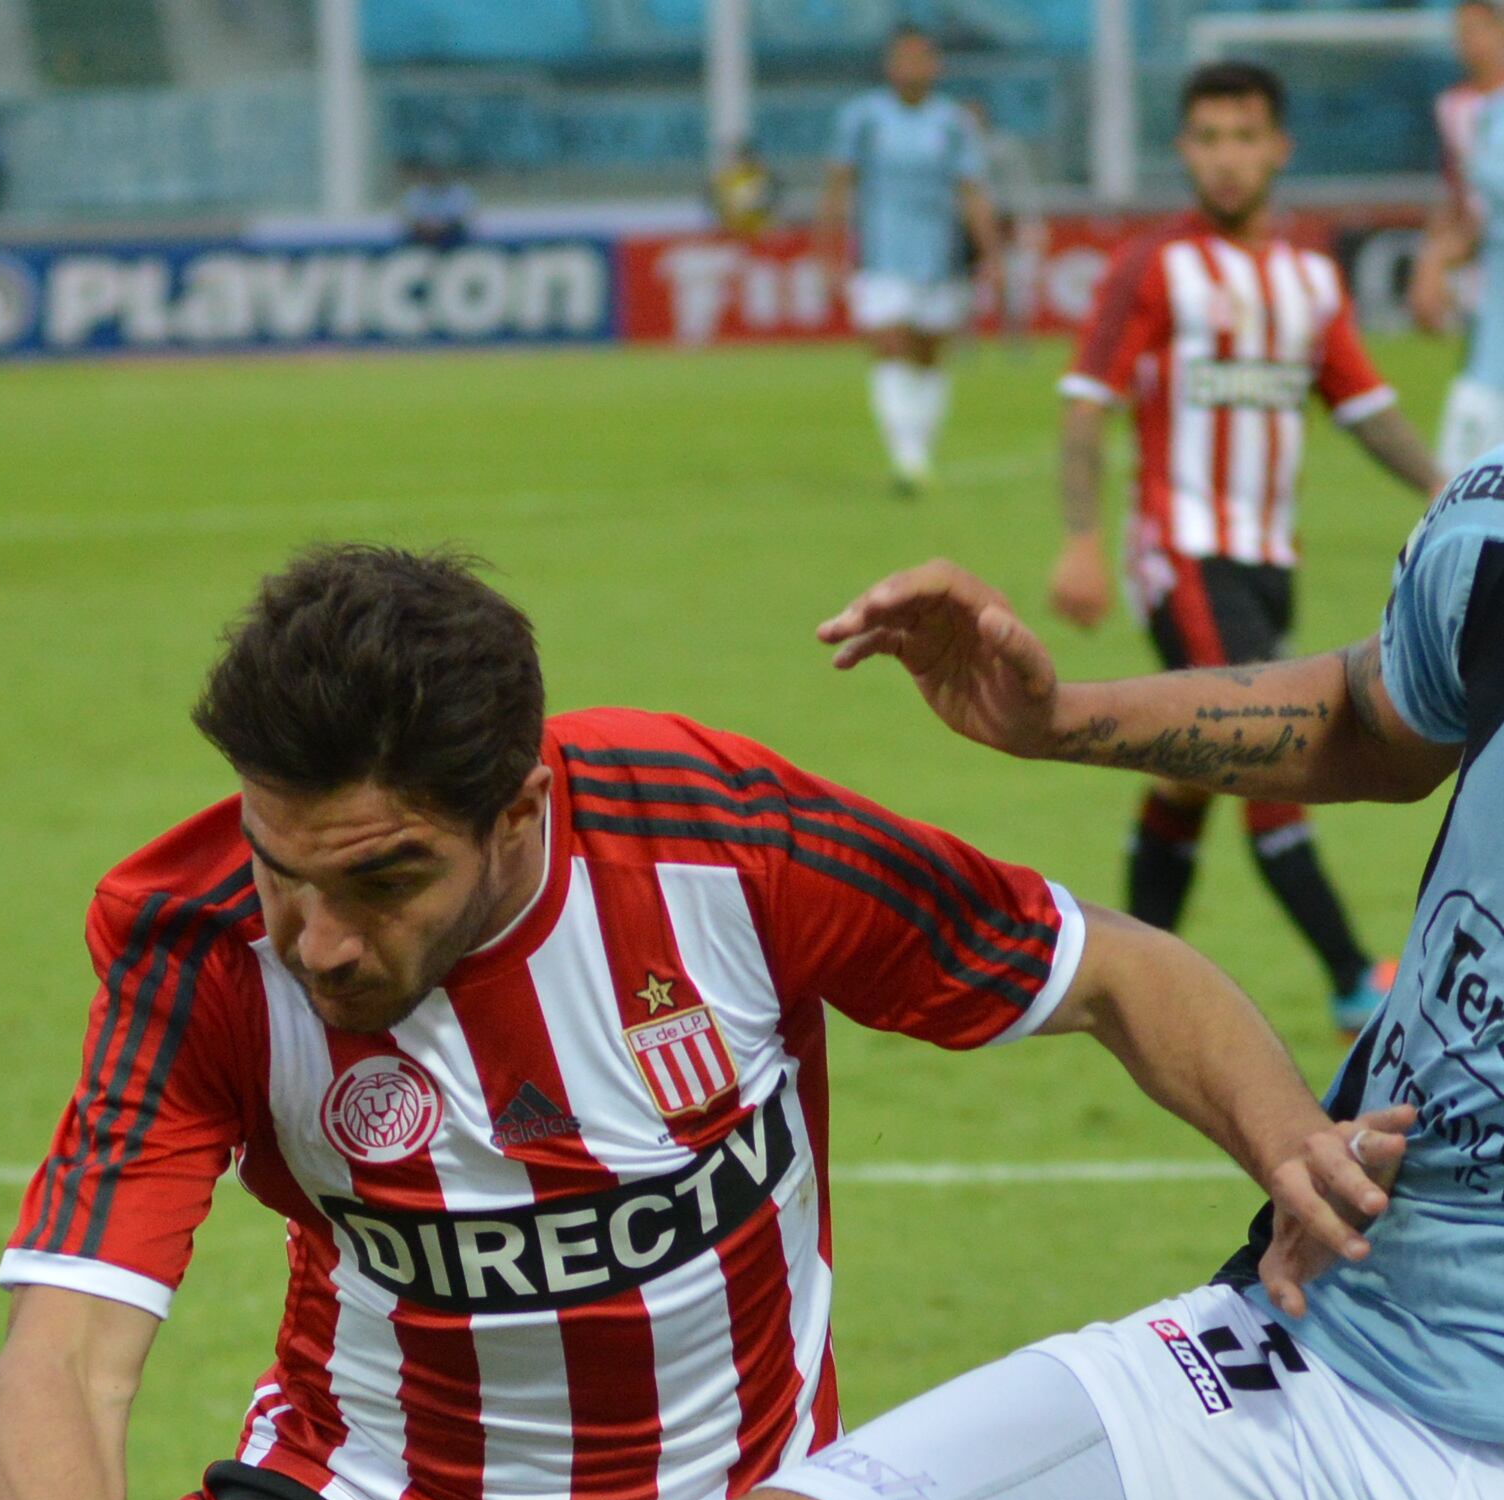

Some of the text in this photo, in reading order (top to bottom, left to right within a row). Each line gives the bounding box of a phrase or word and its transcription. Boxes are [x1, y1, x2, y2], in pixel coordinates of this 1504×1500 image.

[656, 1028, 678, 1041] de
[680, 1015, 704, 1031] L.P.
[490, 1116, 581, 1149] adidas
[344, 1106, 768, 1300] DIRECTV
[1170, 1340, 1224, 1411] lotto
